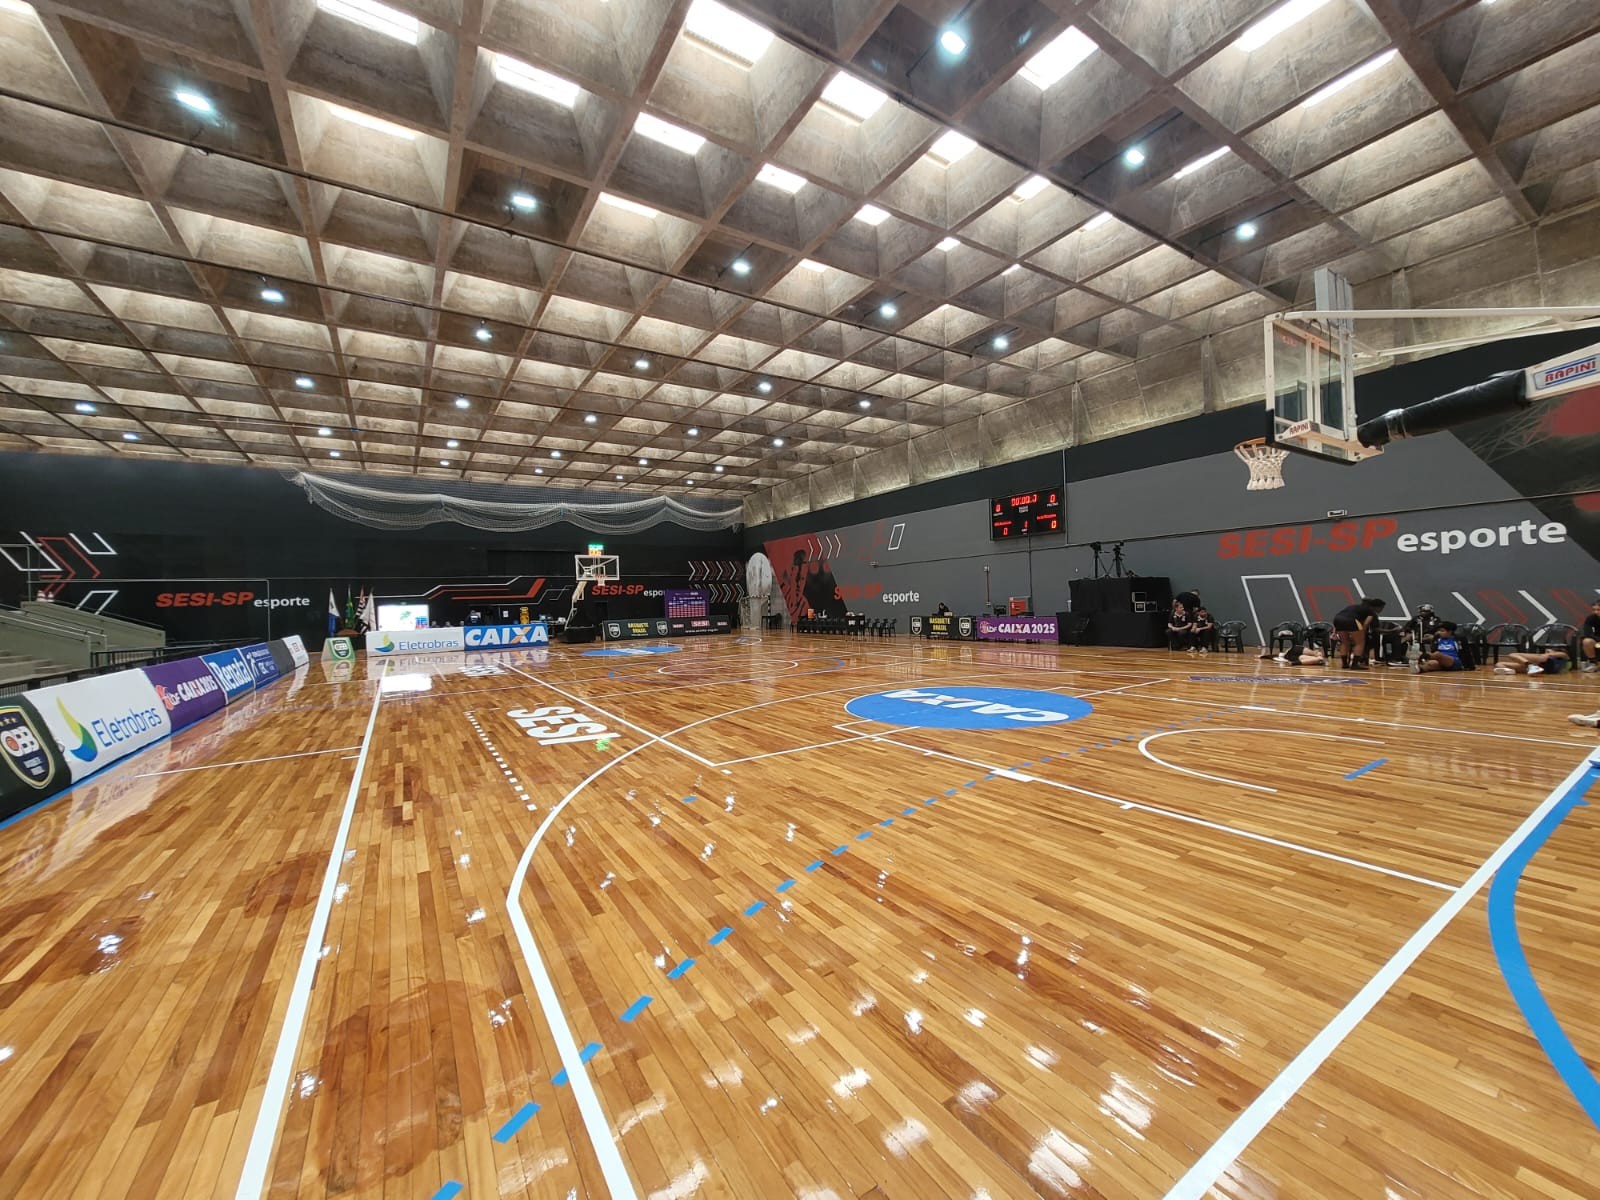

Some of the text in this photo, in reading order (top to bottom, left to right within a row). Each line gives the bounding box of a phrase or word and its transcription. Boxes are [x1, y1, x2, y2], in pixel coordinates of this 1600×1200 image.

[1544, 361, 1596, 382] RAPINI
[1289, 422, 1309, 435] RAPINI
[1217, 517, 1567, 559] SESI-SP esporte
[155, 592, 311, 609] SESI-SP esporte
[591, 585, 644, 596] SESI-SP
[882, 590, 920, 605] esporte
[465, 626, 549, 647] CAIXA
[998, 623, 1031, 634] CAIXA
[1031, 623, 1056, 634] 2025
[399, 639, 459, 651] Eletrobras
[208, 657, 253, 691] Renata
[881, 689, 1070, 722] CAIXA
[91, 708, 162, 747] Eletrobras
[507, 706, 622, 746] SESI
